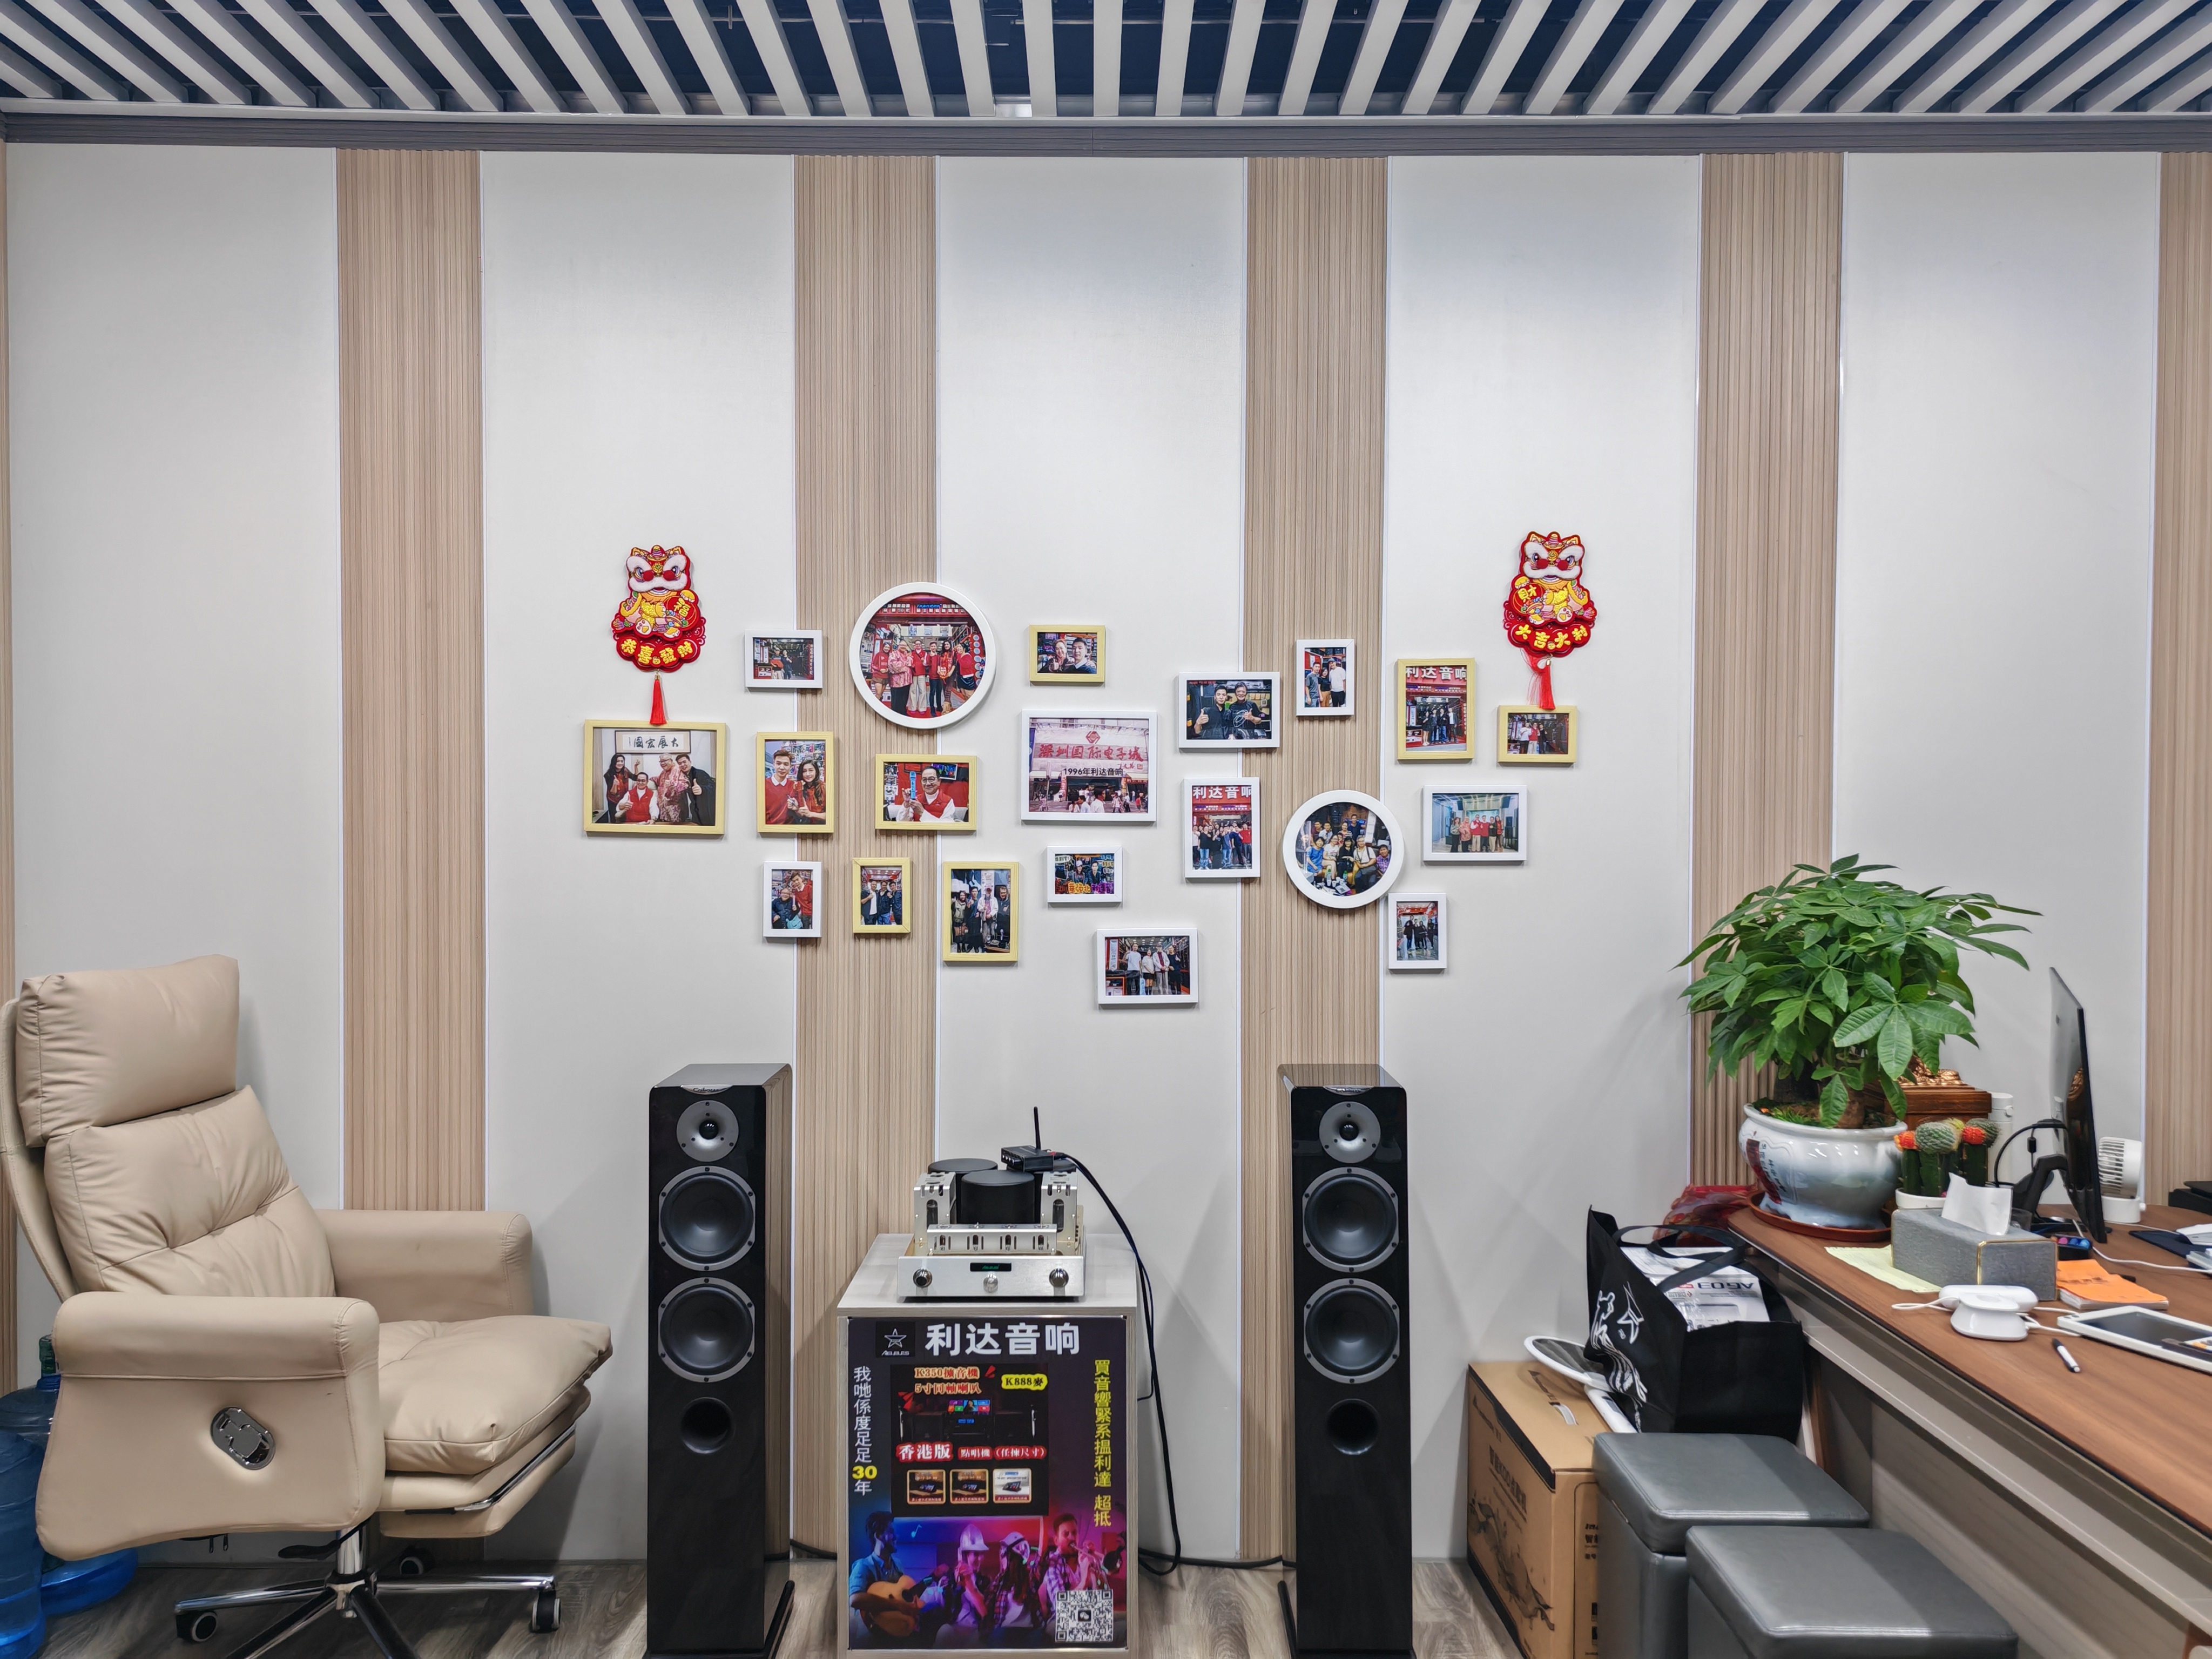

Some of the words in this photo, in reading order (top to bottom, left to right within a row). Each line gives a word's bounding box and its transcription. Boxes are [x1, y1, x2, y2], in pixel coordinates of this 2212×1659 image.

[1518, 585, 1537, 603] 財
[674, 598, 691, 617] 福
[1515, 624, 1588, 649] 大吉大利
[621, 639, 693, 664] 恭喜發財
[1038, 744, 1144, 761] 深圳国际电子城
[1064, 768, 1123, 776] 1996年利达音响
[925, 1323, 1079, 1356] 利达音响
[899, 1444, 950, 1460] 香港版
[1094, 1494, 1111, 1527] 超抵
